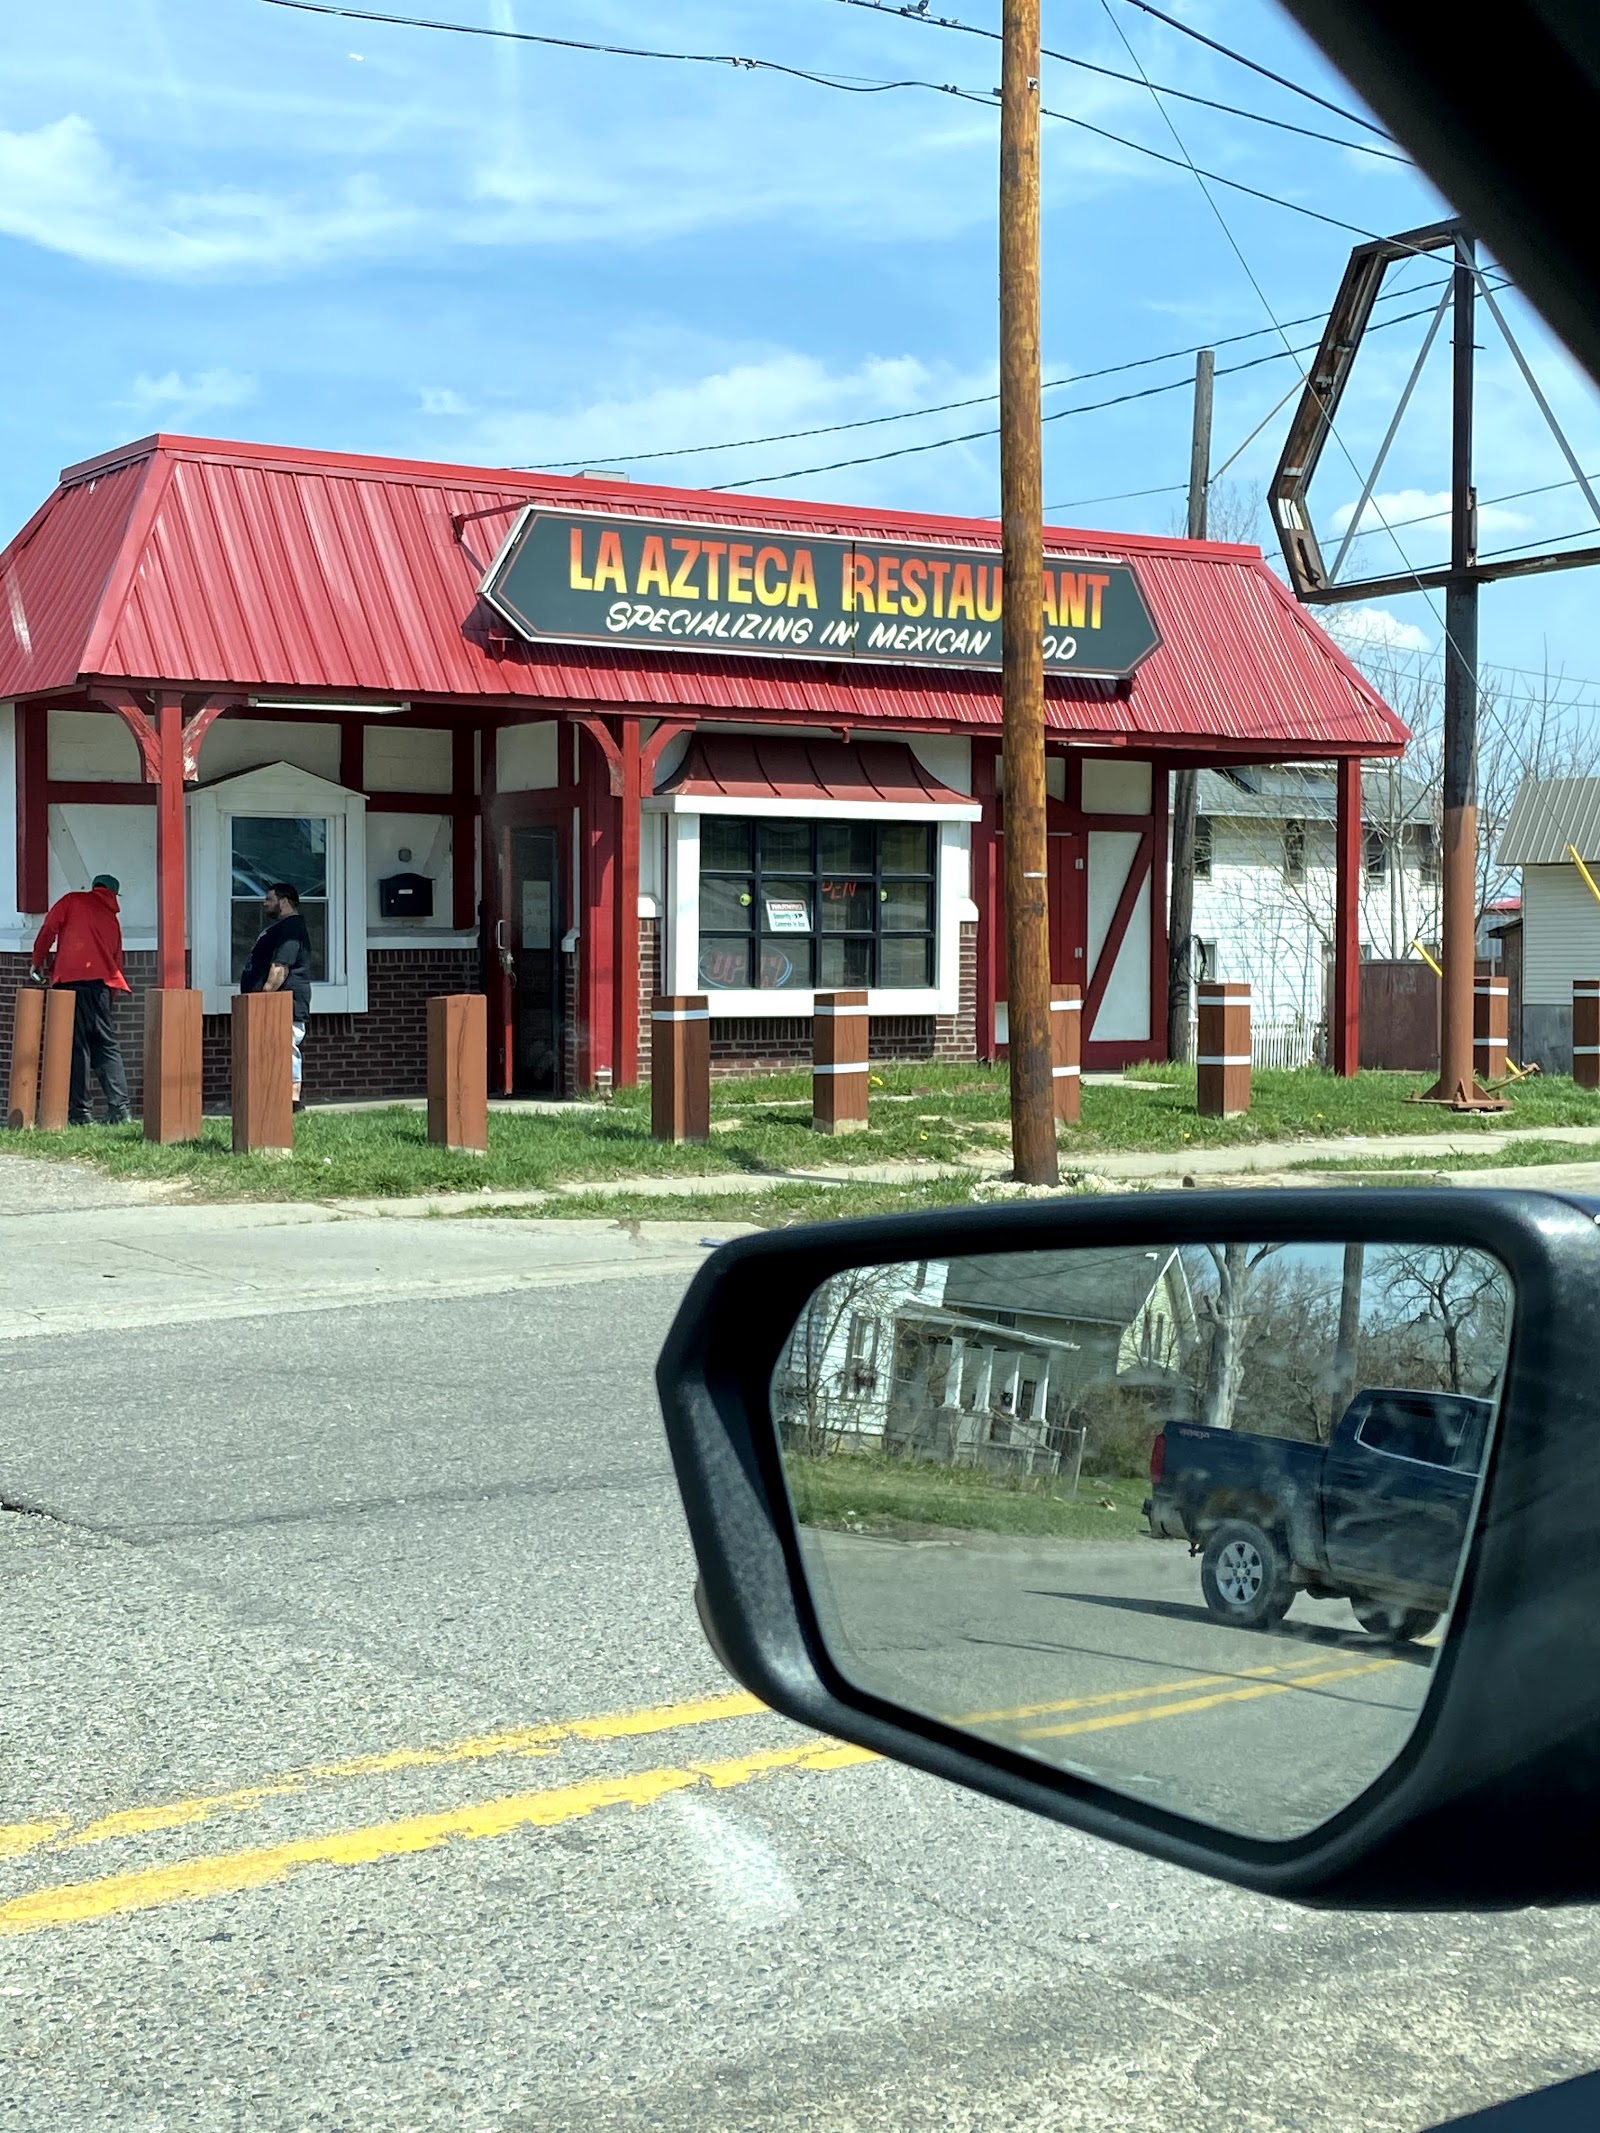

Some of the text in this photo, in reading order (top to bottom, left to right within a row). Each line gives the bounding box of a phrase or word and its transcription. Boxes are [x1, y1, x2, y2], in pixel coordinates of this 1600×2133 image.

[569, 527, 1111, 630] LA AZTECA RESTAUANT
[606, 601, 814, 645] SPECIALIZING
[819, 620, 859, 647] IN
[867, 621, 992, 656] MEXICAN
